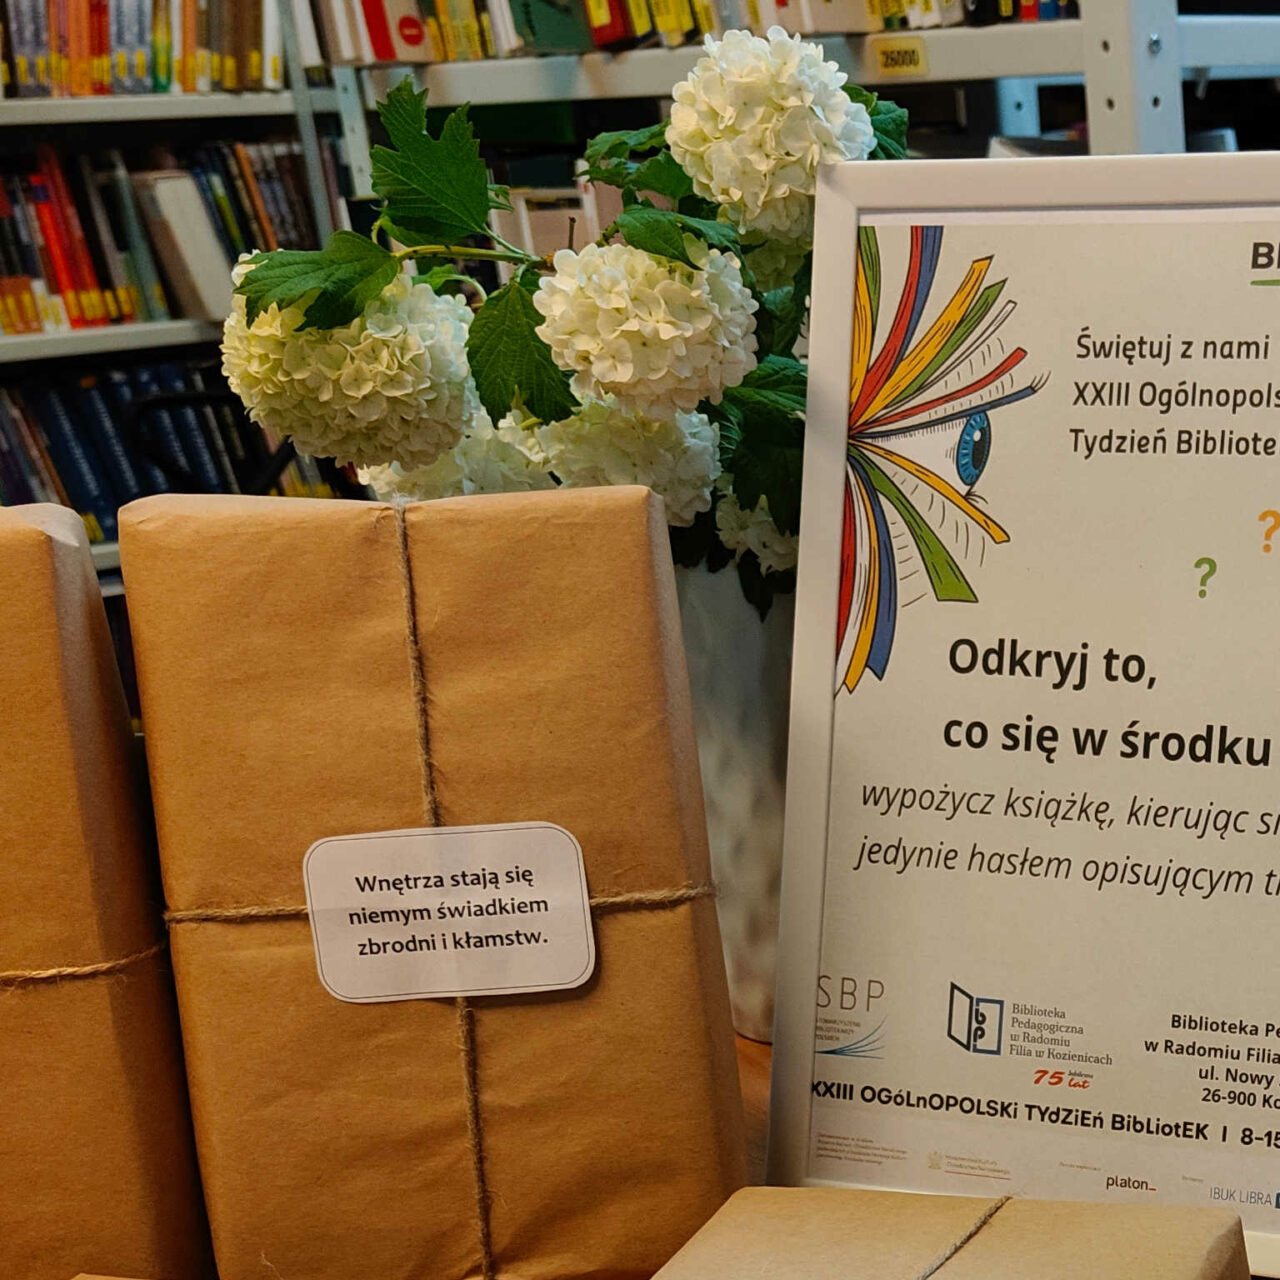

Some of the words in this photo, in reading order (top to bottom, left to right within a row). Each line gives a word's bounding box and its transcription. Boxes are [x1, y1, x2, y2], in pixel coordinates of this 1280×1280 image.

[1076, 326, 1171, 366] Świętuj
[1181, 339, 1193, 360] z
[1203, 334, 1270, 361] nami
[1072, 381, 1130, 407] XXIII
[1069, 428, 1168, 460] Tydzień
[1194, 557, 1217, 599] ?
[948, 637, 1089, 690] Odkryj
[1103, 647, 1158, 689] to,
[943, 717, 988, 749] co
[1001, 715, 1058, 763] się
[1073, 726, 1107, 756] w
[1120, 720, 1270, 767] środku
[862, 782, 995, 820] wypożycz
[1003, 787, 1117, 830] książkę,
[1127, 796, 1248, 840] kierując
[355, 874, 444, 896] Wnętrza
[450, 867, 500, 890] stają
[505, 865, 534, 888] się
[853, 835, 958, 874] jedynie
[967, 845, 1071, 880] hasłem
[1081, 857, 1252, 900] opisującym
[349, 907, 431, 927] niemym
[437, 898, 549, 919] świadkiem
[358, 933, 436, 956] zbrodni
[441, 933, 448, 950] i
[453, 929, 548, 950] kłamstw.
[816, 975, 885, 1013] SBP
[1012, 1003, 1066, 1019] Biblioteka
[1011, 1016, 1084, 1035] Pedagogiczna
[1171, 1014, 1259, 1037] Biblioteka
[1010, 1033, 1020, 1042] w
[1022, 1031, 1071, 1047] Radomiu
[1144, 1040, 1159, 1052] w
[1163, 1039, 1241, 1061] Radomiu
[1009, 1044, 1032, 1057] Filia
[1035, 1049, 1045, 1058] w
[1047, 1047, 1113, 1066] Kozienicach
[1034, 1069, 1066, 1086] 75
[1199, 1065, 1219, 1081] ul.
[1225, 1068, 1274, 1089] Nowy
[1201, 1087, 1257, 1107] 26-900
[1209, 1187, 1236, 1201] IBUK
[1239, 1190, 1272, 1206] LIBRA
